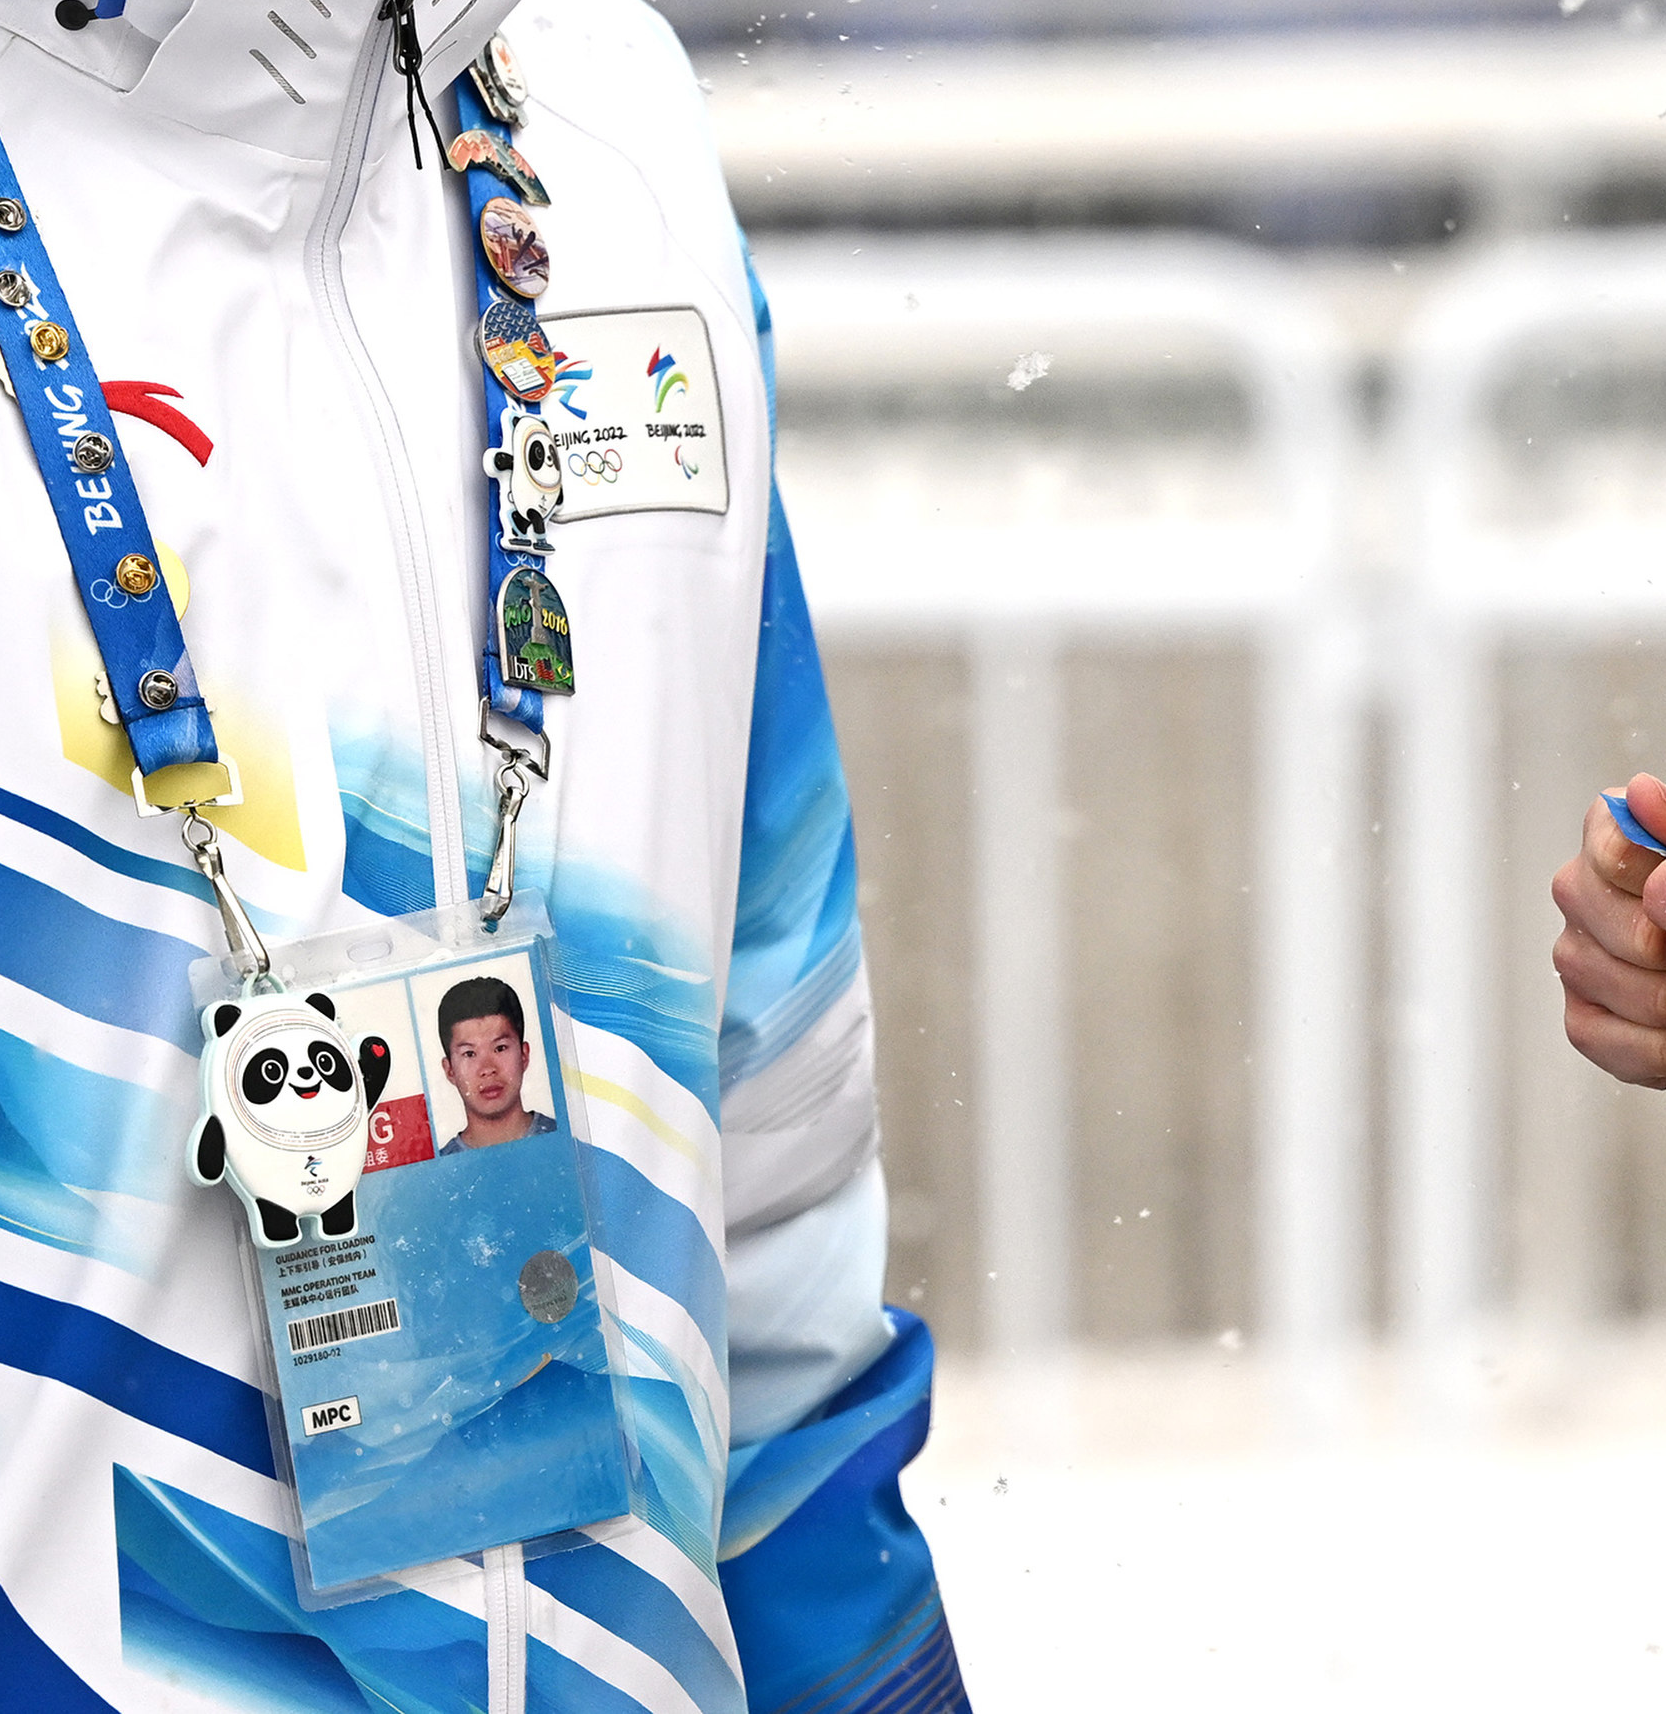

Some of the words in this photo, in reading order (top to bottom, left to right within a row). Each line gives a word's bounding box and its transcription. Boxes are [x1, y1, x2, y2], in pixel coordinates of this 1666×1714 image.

[553, 429, 591, 451] EIJING
[593, 426, 629, 443] 2022
[645, 423, 683, 442] BEIJING
[684, 424, 707, 439] 2022
[44, 383, 114, 537] BENG
[542, 608, 569, 636] 2016
[275, 1248, 319, 1265] GUIDANCE
[319, 1243, 337, 1255] FOR
[337, 1235, 376, 1251] LOADING
[281, 1285, 303, 1298] MMC
[303, 1273, 351, 1292] OPERATION
[351, 1268, 376, 1281] TEAM
[293, 1347, 342, 1367] 1029180-02
[312, 1404, 352, 1429] MPC
